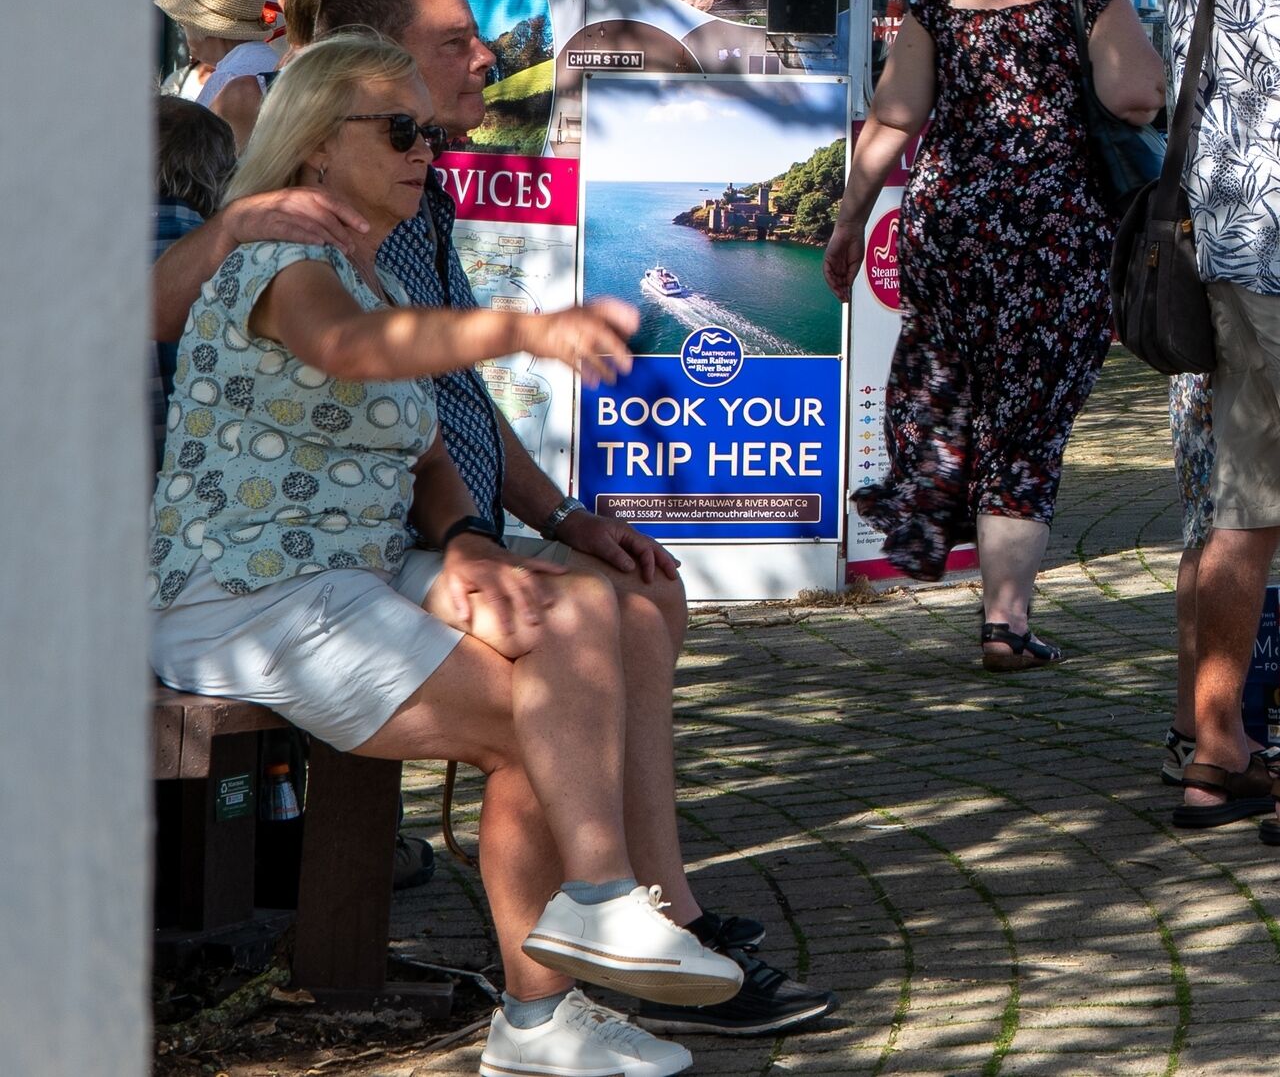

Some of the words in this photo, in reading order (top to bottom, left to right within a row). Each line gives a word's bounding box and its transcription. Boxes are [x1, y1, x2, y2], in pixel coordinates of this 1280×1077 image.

[569, 55, 639, 65] CHURSTON
[872, 266, 898, 278] Steam
[686, 356, 708, 364] Steam
[709, 356, 738, 366] Railway
[597, 397, 707, 427] BOOK
[719, 397, 826, 427] YOUR
[597, 441, 693, 476] TRIP
[708, 442, 822, 476] HERE
[608, 499, 666, 507] DARTMOUTH
[667, 499, 698, 507] STEAM
[699, 499, 735, 507] RAILWAY
[735, 499, 743, 507] &
[744, 499, 769, 507] RIVER
[770, 499, 794, 507] BOAT
[615, 510, 635, 518] 01803
[636, 510, 662, 518] 555872
[666, 509, 799, 518] www.dartmouthrailriver.co.uk
